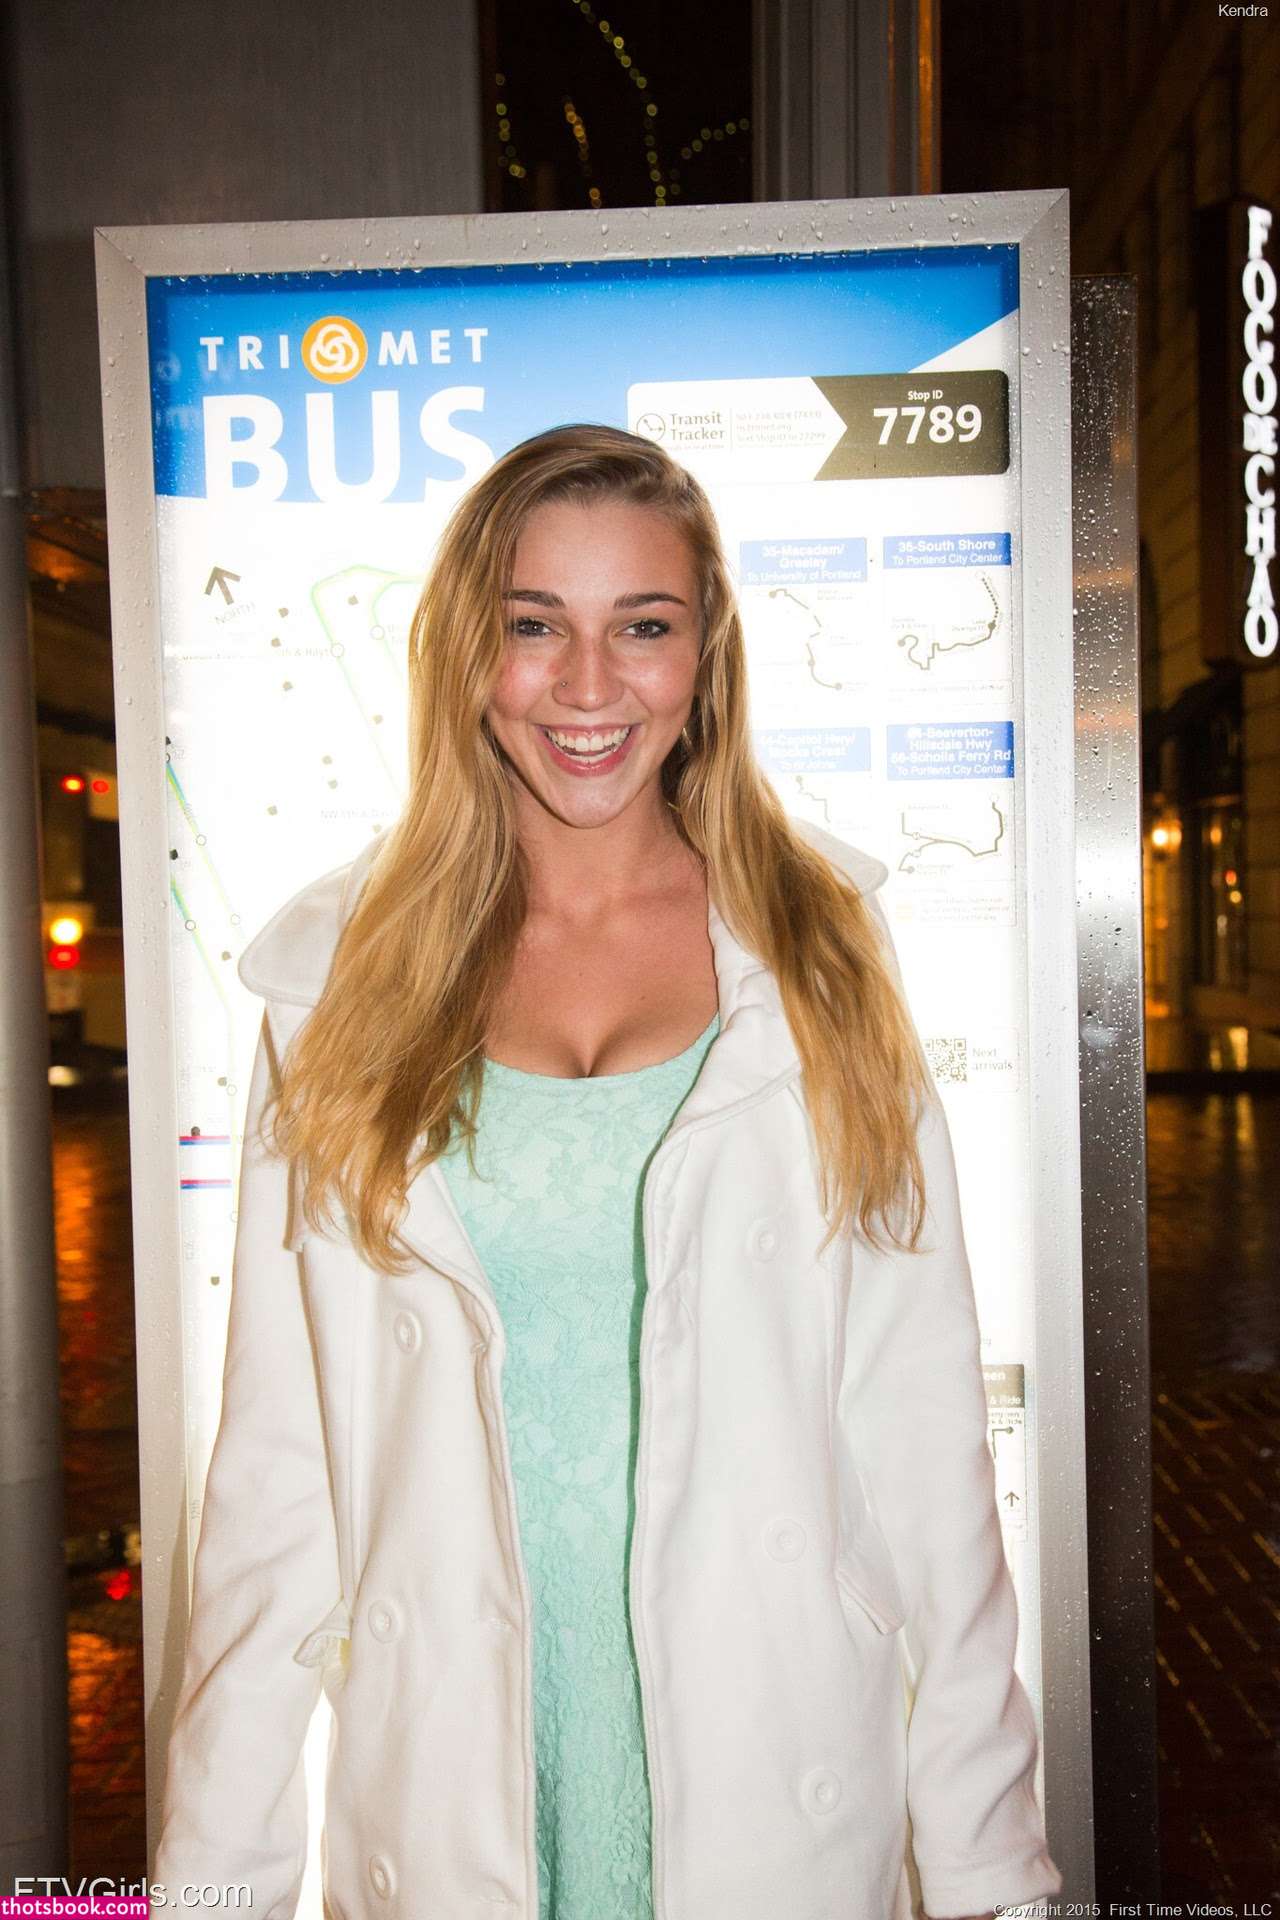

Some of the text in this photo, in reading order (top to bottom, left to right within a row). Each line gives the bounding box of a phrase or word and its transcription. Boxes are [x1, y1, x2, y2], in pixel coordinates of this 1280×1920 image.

[200, 334, 290, 371] TRI
[378, 327, 489, 366] MET
[907, 389, 943, 402] Stop ID
[669, 411, 723, 425] Transit
[873, 404, 983, 446] 7789
[670, 427, 727, 441] Tracker
[202, 386, 497, 503] BUS
[958, 538, 997, 551] Shore
[892, 552, 1003, 565] To Portland City Center
[965, 738, 993, 752] Hwy
[958, 750, 991, 765] Ferry
[994, 749, 1011, 761] Rd
